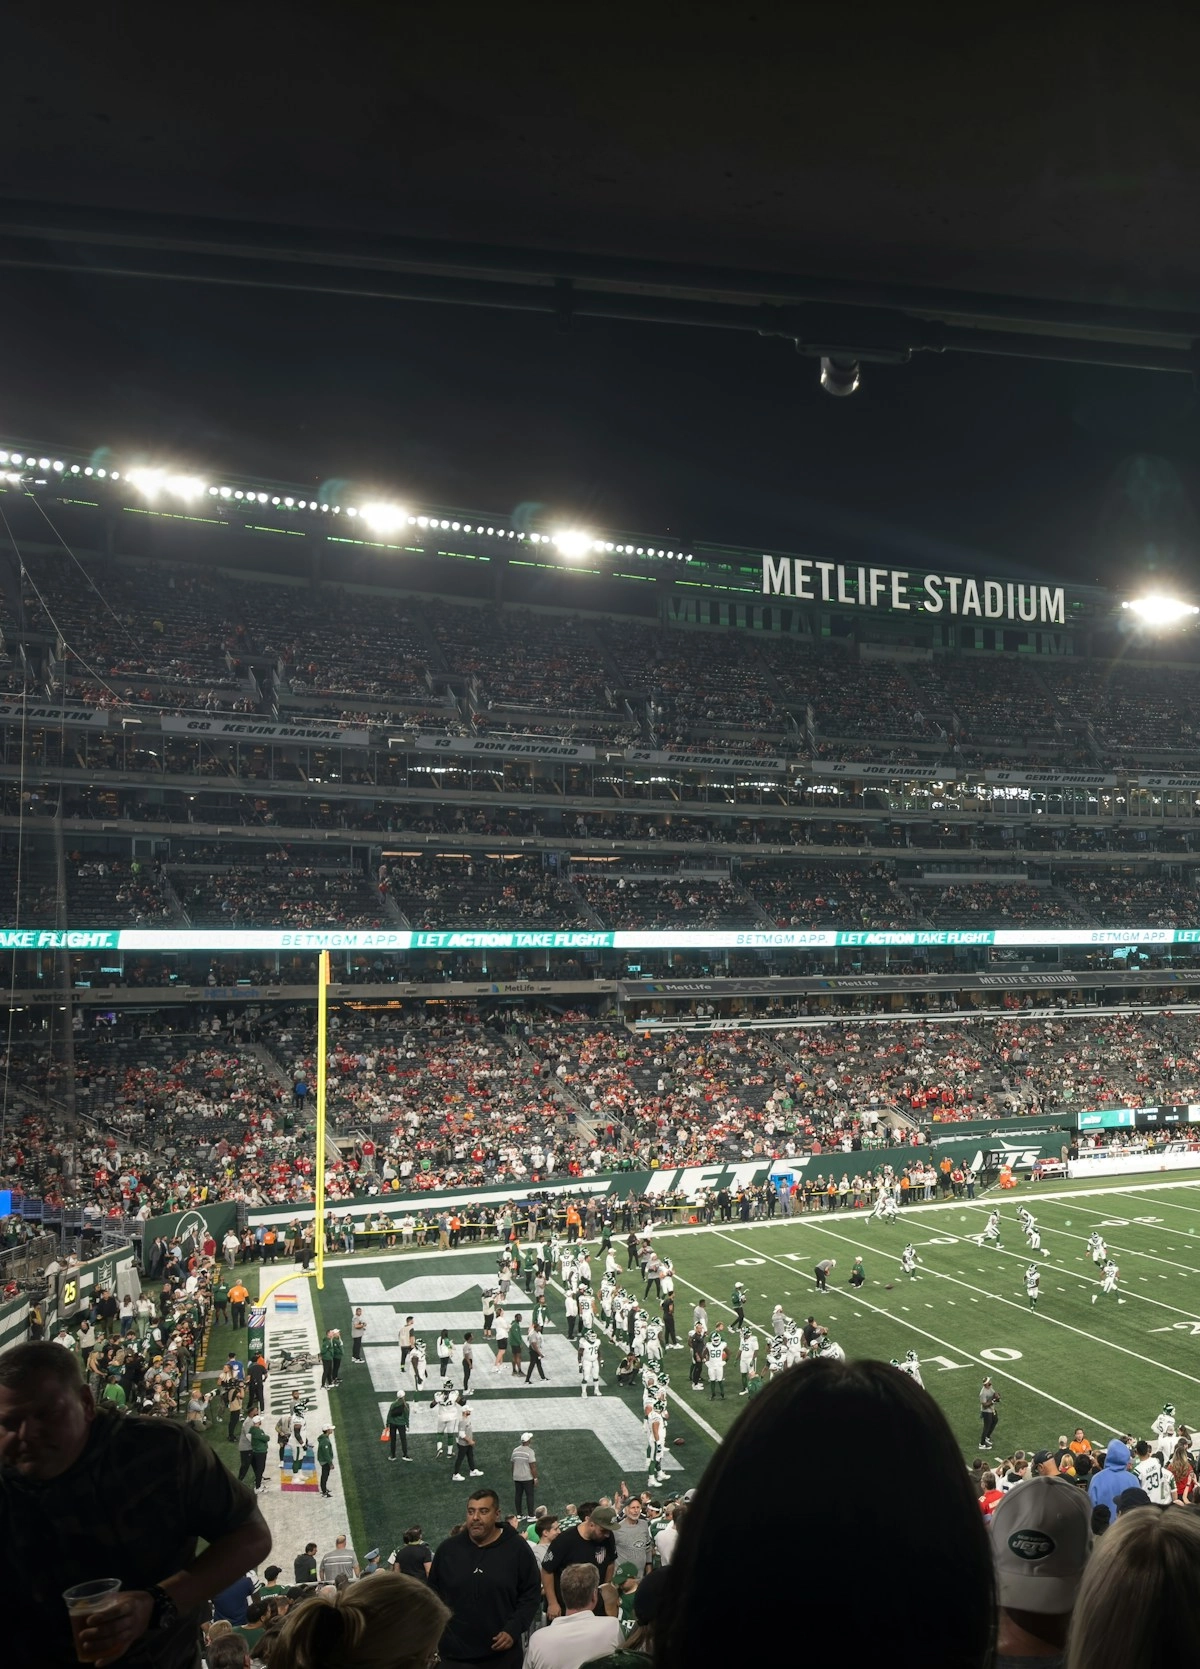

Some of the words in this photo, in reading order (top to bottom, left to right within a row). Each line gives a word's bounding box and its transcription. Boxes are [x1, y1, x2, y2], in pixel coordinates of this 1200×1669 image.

[762, 554, 911, 610] METLIFE
[923, 575, 1065, 624] STADIUM
[14, 706, 94, 721] MARTIN
[222, 724, 277, 735] KEVIN
[278, 728, 343, 740] MAWAE
[434, 738, 452, 747] 13
[474, 741, 507, 750] DON
[507, 744, 579, 756] MAYNARD
[632, 752, 651, 760] 24
[668, 755, 731, 766] FREEMAN
[731, 758, 779, 768] MCNEIL
[832, 764, 848, 772] 12
[862, 766, 889, 774] JOE
[888, 768, 937, 777] NAMATH
[1025, 774, 1060, 782] GERRY
[37, 931, 113, 947] FLIGHT.
[281, 934, 358, 947] BETMGM
[417, 934, 449, 947] LET
[449, 933, 513, 947] ACTION
[514, 933, 554, 947] TAKE
[554, 933, 610, 947] FLIGHT.
[736, 934, 795, 945] BETMGM
[841, 932, 864, 946] LET
[864, 932, 915, 946] ACTION
[914, 932, 946, 945] TAKE
[1091, 932, 1138, 942] BETMGM
[1178, 931, 1198, 941] LET
[837, 979, 880, 987] MetLife
[979, 975, 1028, 985] METLIFE
[1029, 974, 1079, 984] STADIUM
[504, 983, 535, 992] MetLife
[665, 983, 712, 991] MetLife
[644, 1157, 812, 1206] JETS
[64, 1280, 77, 1304] 25
[788, 1336, 799, 1345] 70
[710, 1349, 721, 1358] 58
[920, 1347, 1023, 1371] 10
[1146, 1472, 1160, 1491] 33
[1012, 1540, 1051, 1554] JETS
